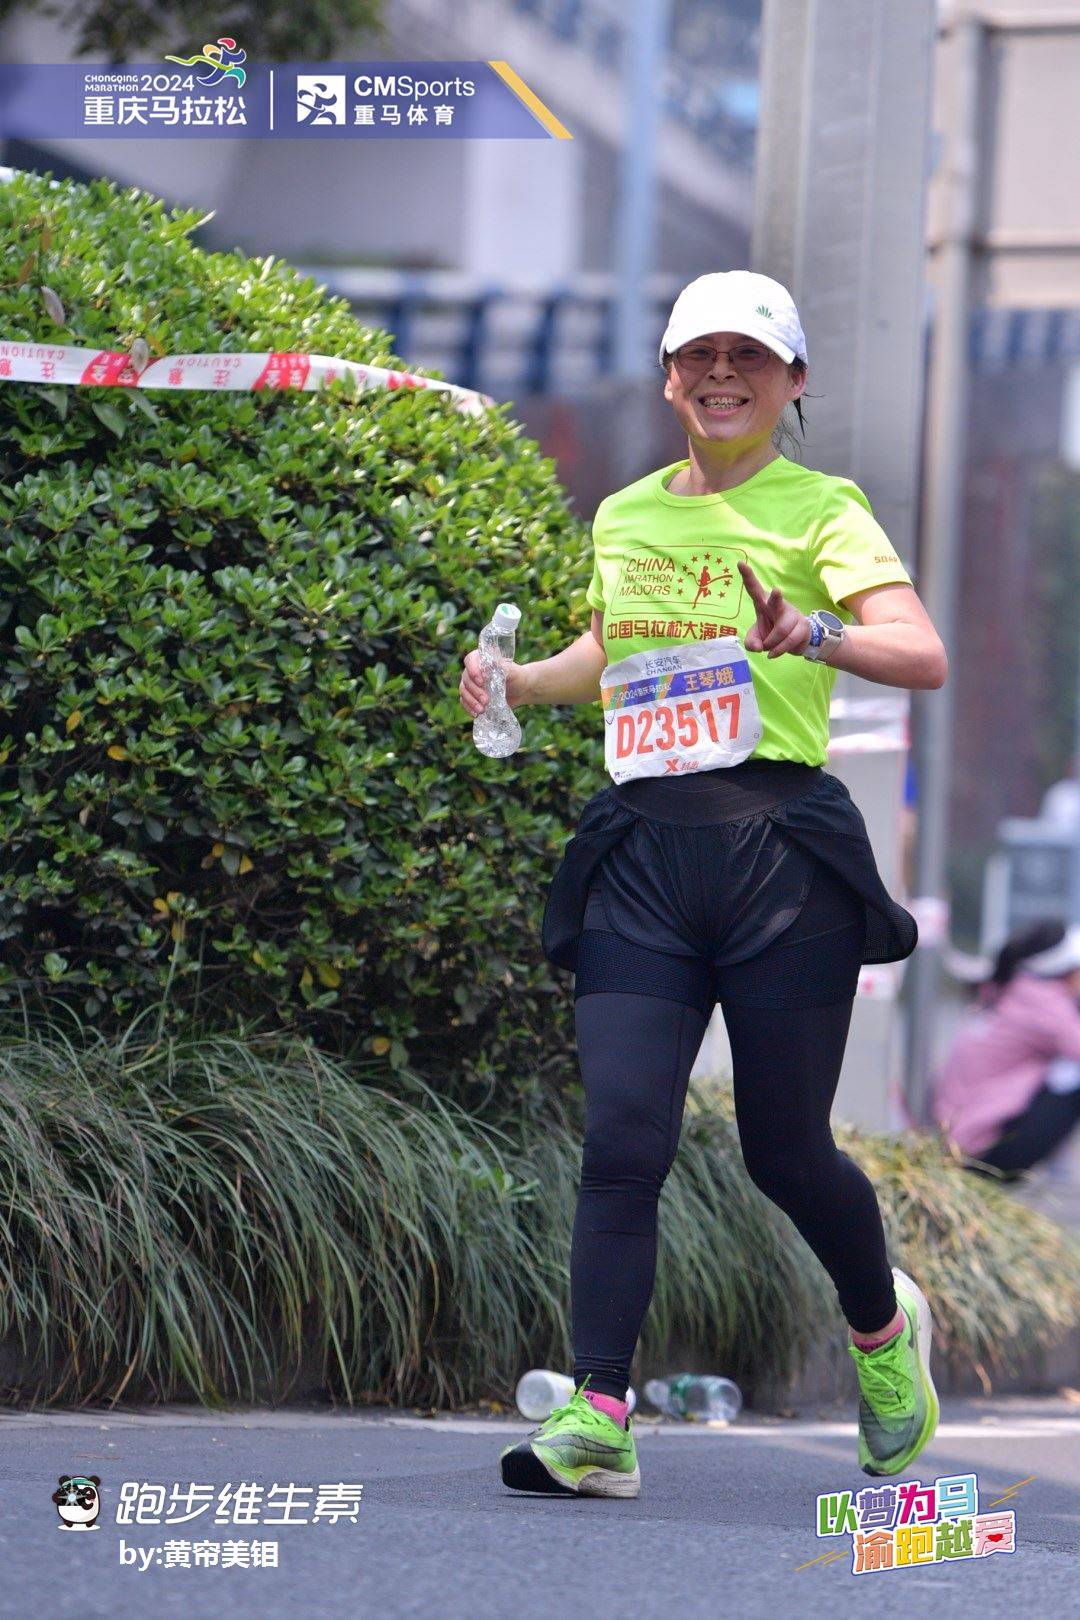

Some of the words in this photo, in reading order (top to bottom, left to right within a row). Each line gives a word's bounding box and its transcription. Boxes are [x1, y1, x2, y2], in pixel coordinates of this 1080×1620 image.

[175, 356, 241, 368] CAUTION
[167, 368, 231, 388] 注意
[626, 557, 676, 573] CHINA
[624, 573, 674, 584] MARATHON
[619, 584, 671, 597] MAJORS
[684, 667, 736, 692] 王琴娥
[615, 693, 741, 759] D23517
